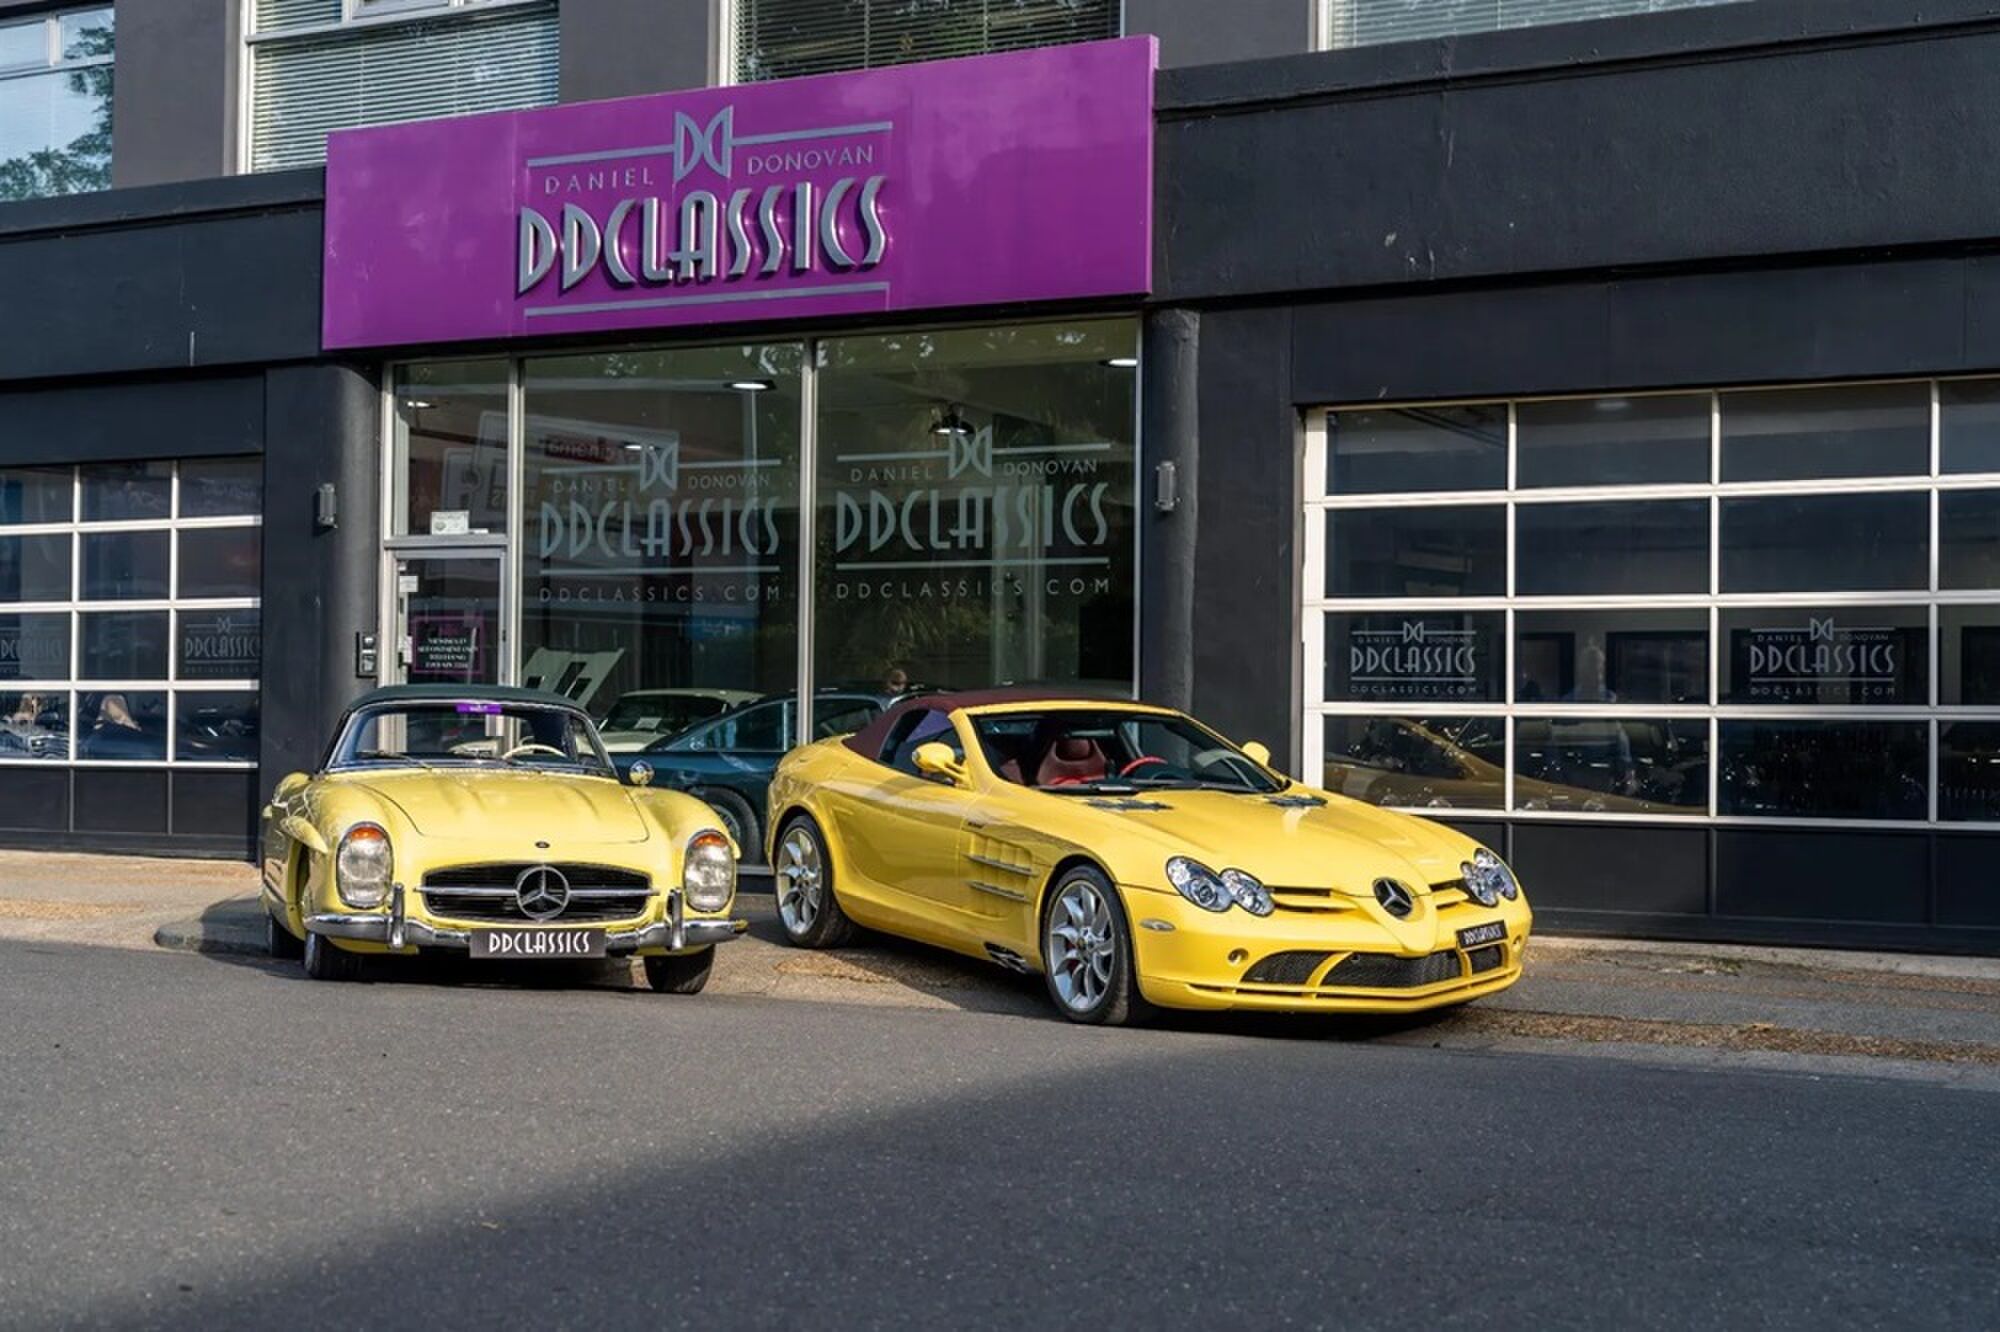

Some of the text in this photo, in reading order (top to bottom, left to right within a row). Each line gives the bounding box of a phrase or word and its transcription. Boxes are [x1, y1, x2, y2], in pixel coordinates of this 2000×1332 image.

[545, 144, 874, 194] DANIEL DONOVAN
[517, 175, 887, 294] DDCLASSICS
[552, 473, 770, 494] DANIEL DONOVAN
[851, 458, 1098, 483] DANIEL DONOVAN
[540, 496, 780, 559] DDCLASSICS
[836, 482, 1109, 552] DDCLASSICS
[1350, 646, 1476, 673] DDCLASSICS
[1750, 644, 1896, 674] DDCLASSICS
[488, 931, 591, 954] DDCLASSICS
